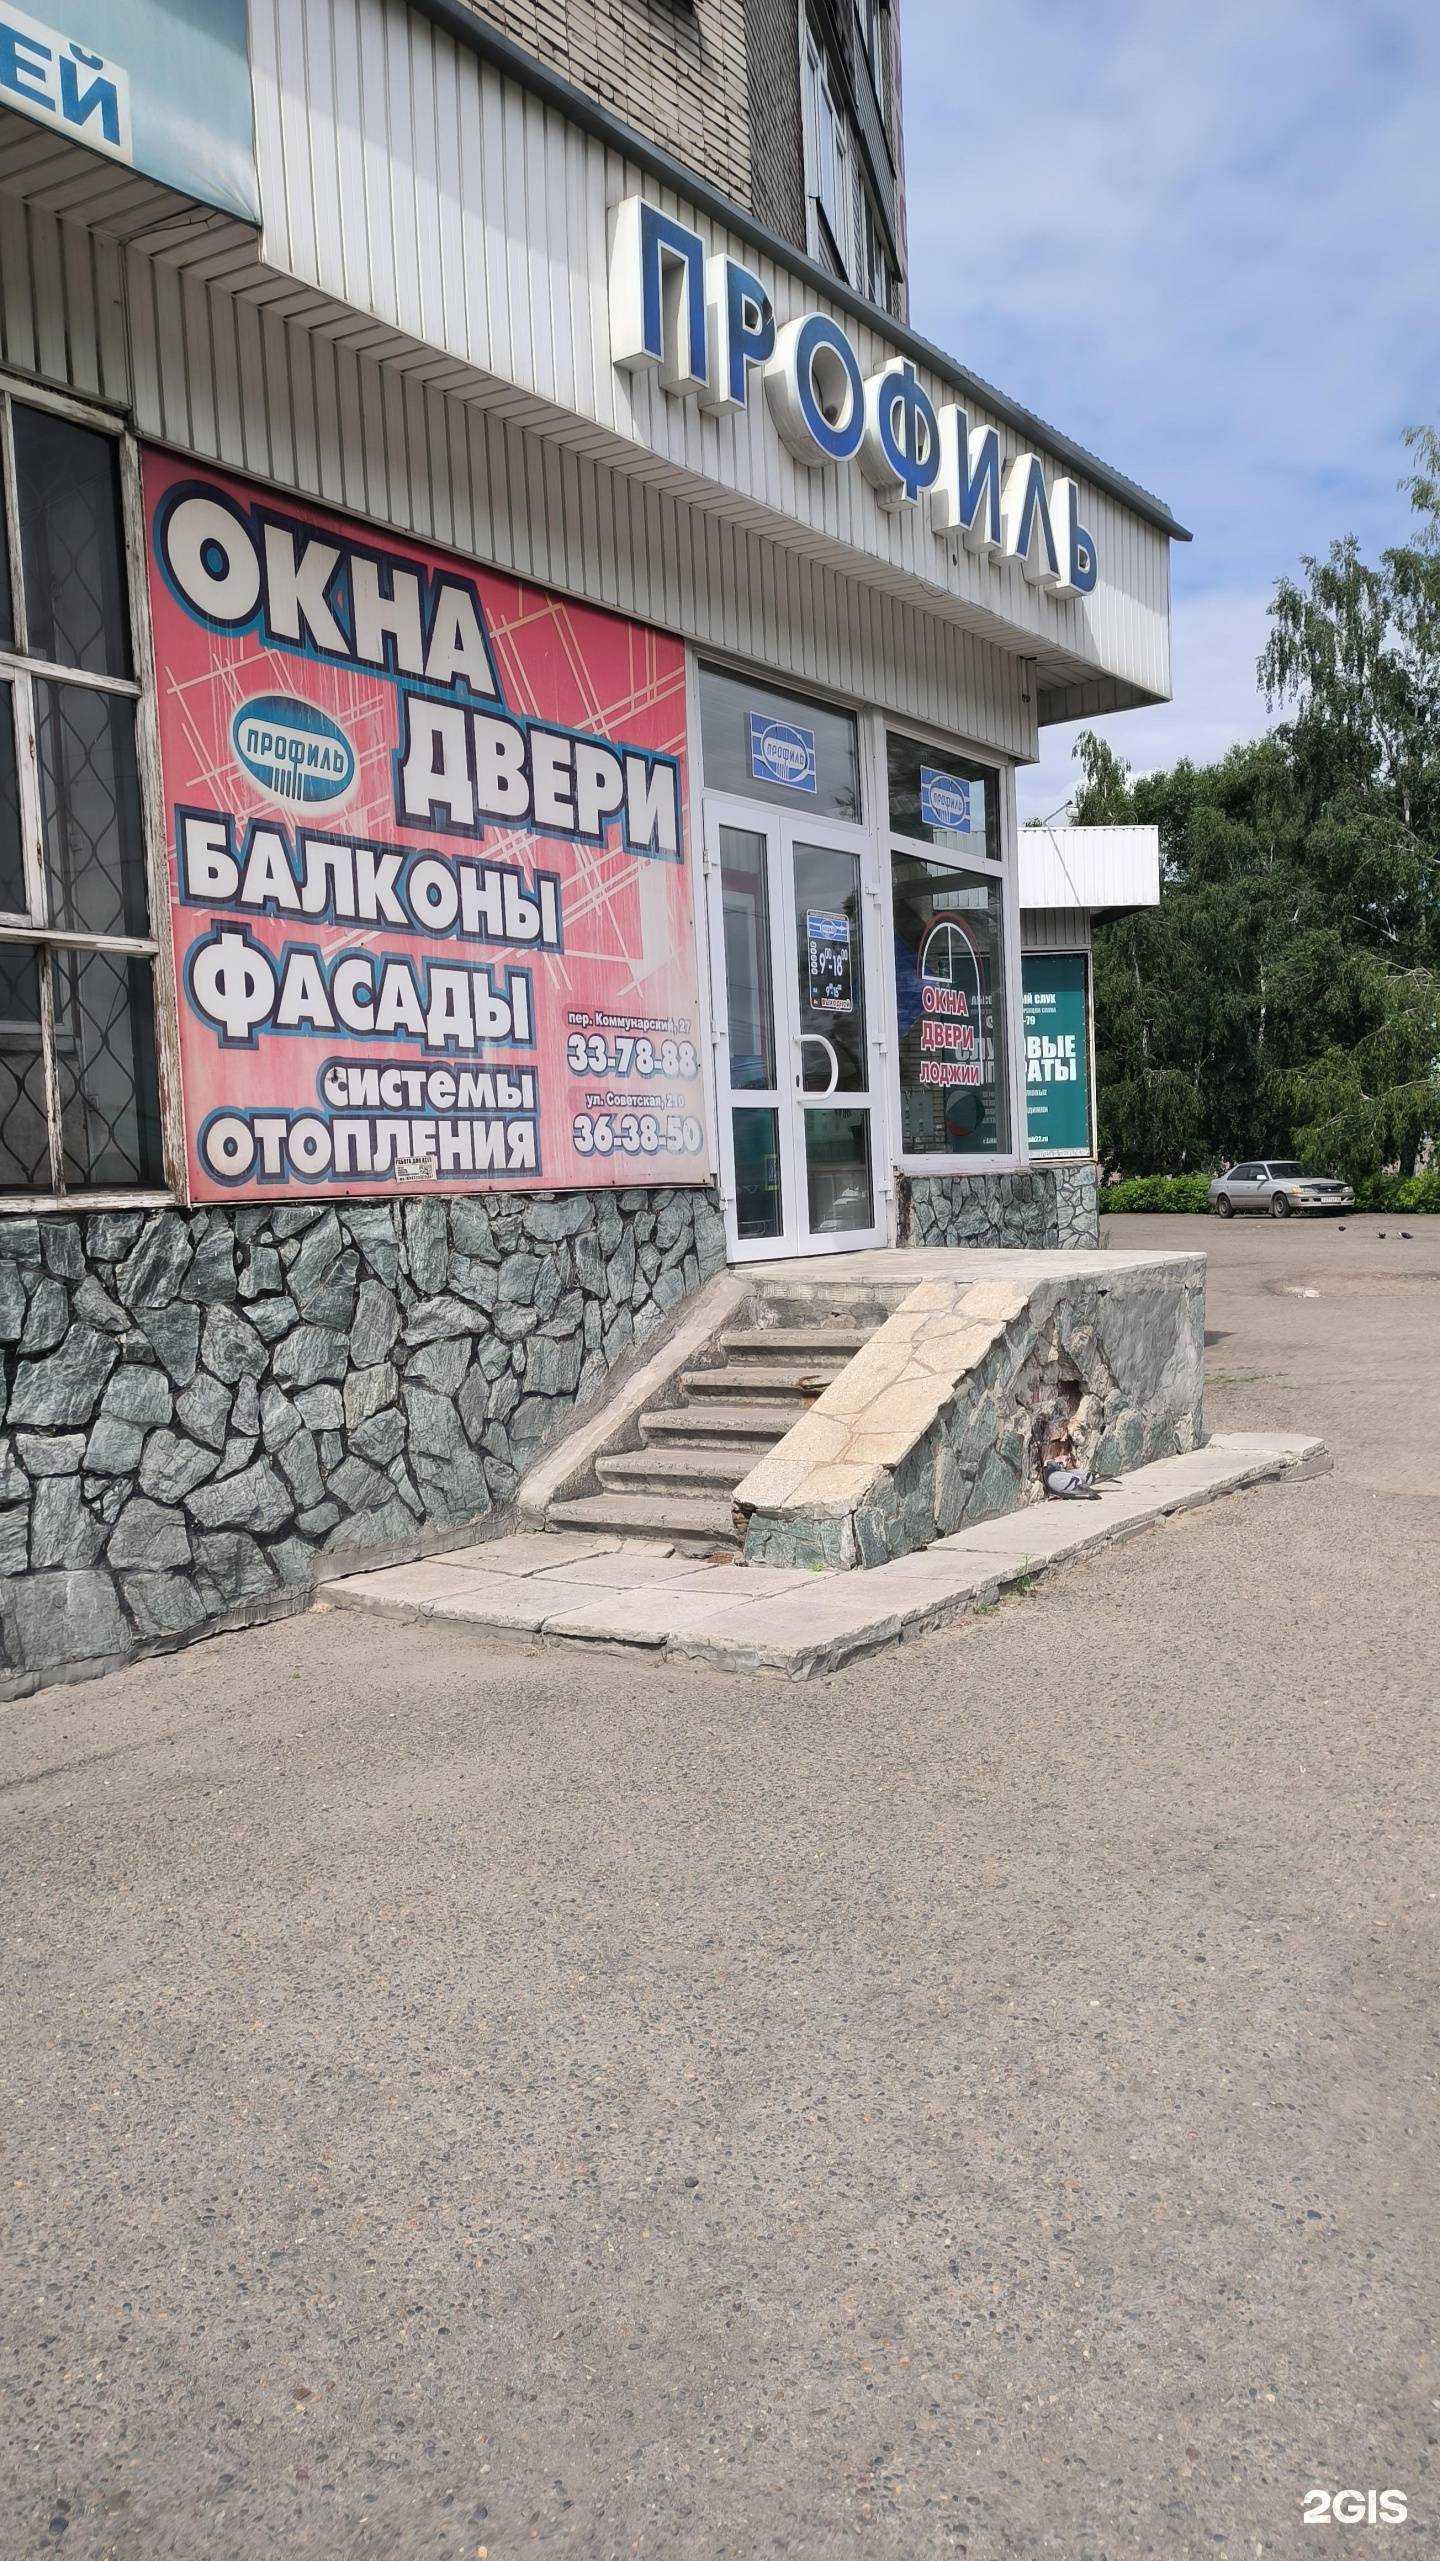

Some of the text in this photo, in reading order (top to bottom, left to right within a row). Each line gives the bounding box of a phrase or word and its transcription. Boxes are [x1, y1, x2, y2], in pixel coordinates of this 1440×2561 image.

[0, 21, 121, 148] ЕЙ
[622, 196, 1099, 599] ПРОФИЛЬ
[164, 496, 499, 701] ОКНА
[246, 727, 345, 774] ПРОФИЛЬ
[401, 695, 679, 856] ДВЕРИ
[183, 816, 561, 945] БАЛКОНЫ
[191, 931, 528, 1050] ФАСАДЫ
[921, 985, 969, 1017] ОКНА
[568, 1011, 593, 1028] пер.
[921, 1020, 974, 1052] ДВЕРИ
[566, 1032, 698, 1078] 33-78-88
[919, 1060, 982, 1088] ЛОДЖИИ
[586, 1093, 605, 1109] ул.
[204, 1116, 537, 1176] ОТОПЛЕНИЯ
[572, 1113, 703, 1155] 36-38-50
